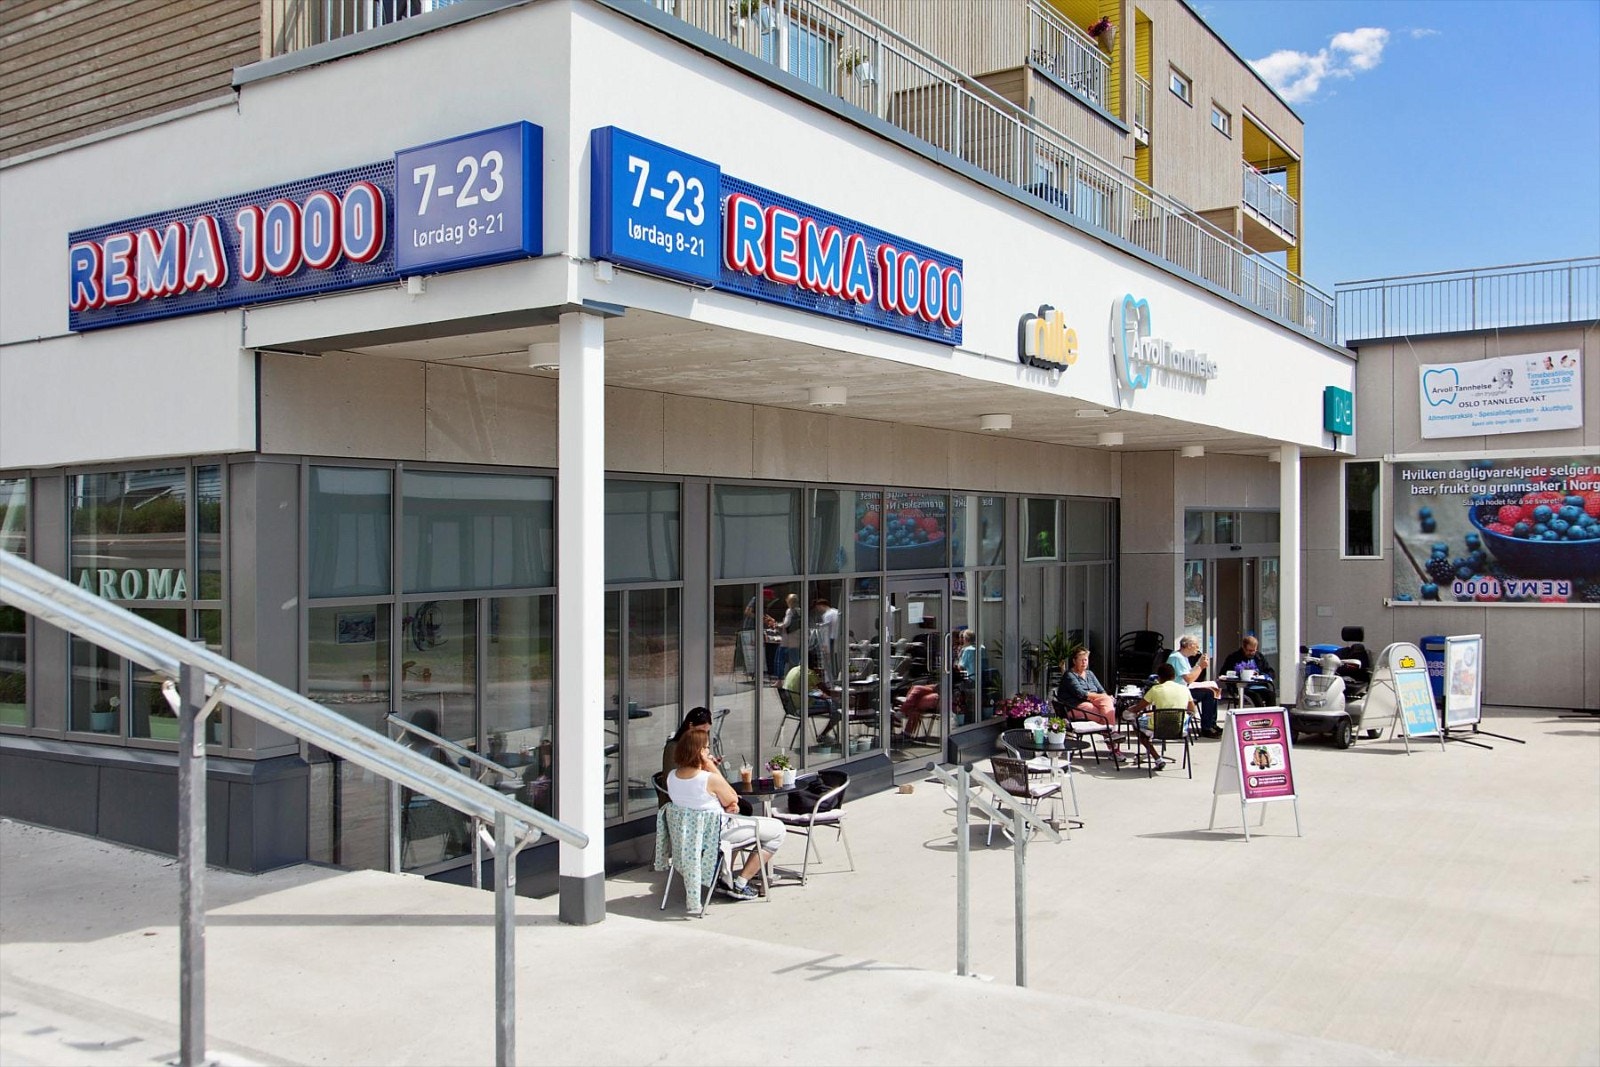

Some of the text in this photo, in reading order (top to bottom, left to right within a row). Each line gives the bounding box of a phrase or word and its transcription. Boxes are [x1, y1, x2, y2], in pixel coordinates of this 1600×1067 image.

[413, 150, 504, 216] 7-23
[628, 155, 705, 226] 7-23
[413, 213, 504, 248] lørdag 8-21
[628, 218, 705, 257] lørdag 8-21
[69, 181, 386, 312] REMA 1000
[724, 193, 963, 328] REMA 1000
[1455, 383, 1492, 392] Tannhelse
[1483, 395, 1547, 406] TANNLEGEVAKT
[1402, 469, 1447, 480] Hvilken
[1448, 466, 1548, 480] dagligvarekjede
[1549, 464, 1589, 478] selger
[1411, 483, 1437, 495] bær,
[1439, 482, 1470, 494] frukt
[1472, 485, 1487, 495] og
[1489, 481, 1560, 495] grønnsaker
[1563, 480, 1567, 491] i
[1475, 499, 1485, 507] på
[78, 569, 187, 600] AROMA
[1453, 580, 1570, 597] REMA 1000
